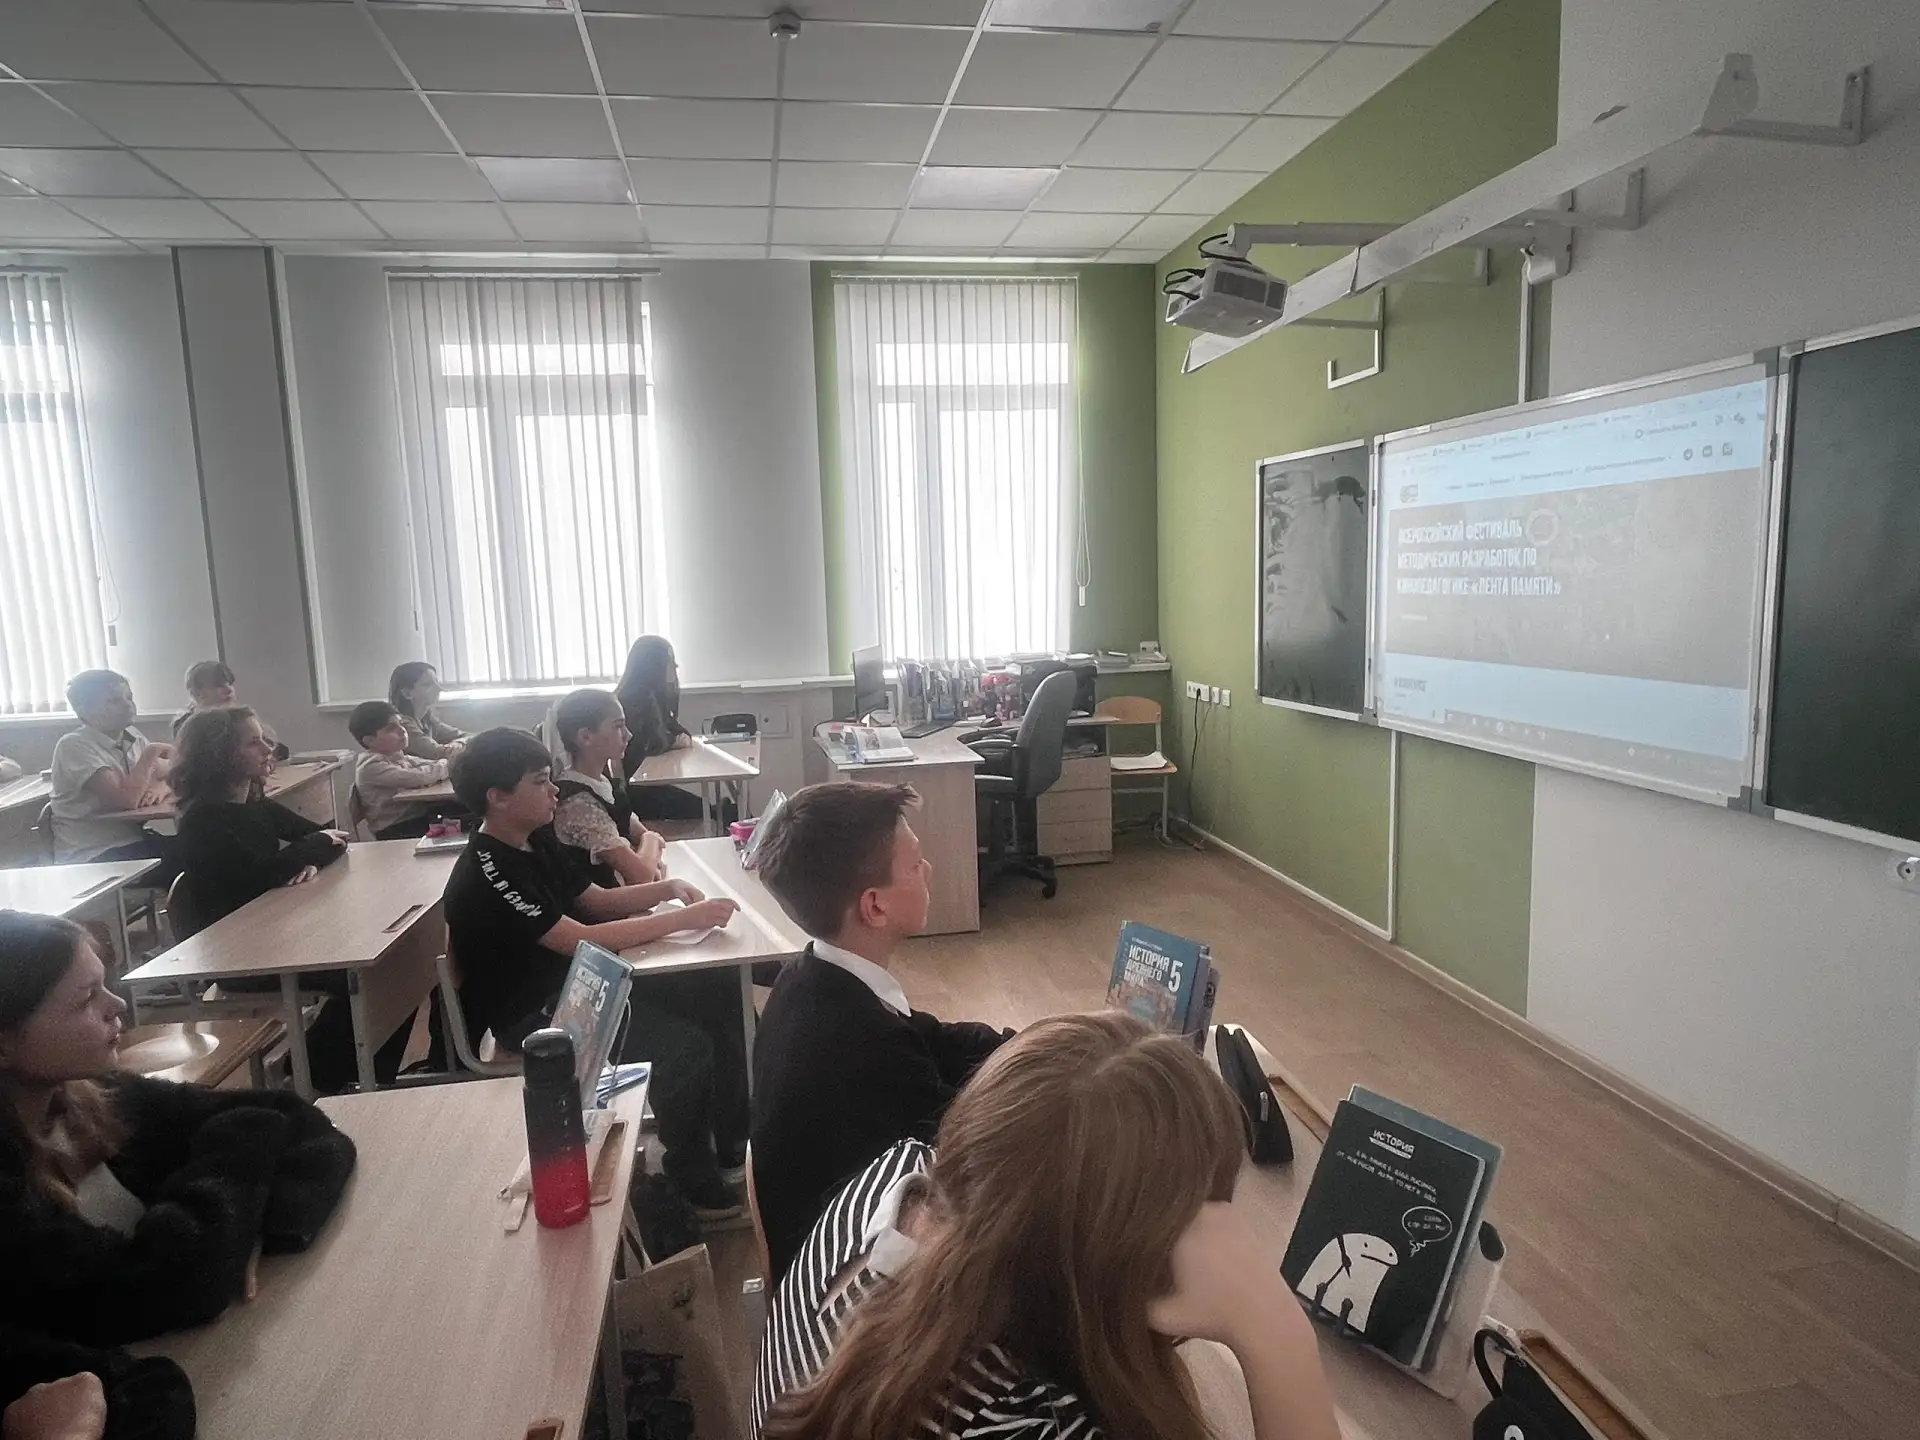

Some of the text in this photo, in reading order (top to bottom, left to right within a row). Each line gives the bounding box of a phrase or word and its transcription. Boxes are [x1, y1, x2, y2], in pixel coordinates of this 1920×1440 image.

[1466, 519, 1522, 541] ФЕСТИВАЛЬ
[1462, 548, 1520, 568] РАЗРАБОТОК
[1523, 547, 1537, 567] ПО
[1125, 958, 1163, 981] ДРЕВНЕГО
[1128, 944, 1170, 972] ИСТОРИЯ
[1168, 960, 1184, 993] 5
[595, 980, 610, 1013] 5
[1372, 1129, 1416, 1154] ИСТОРИЯ
